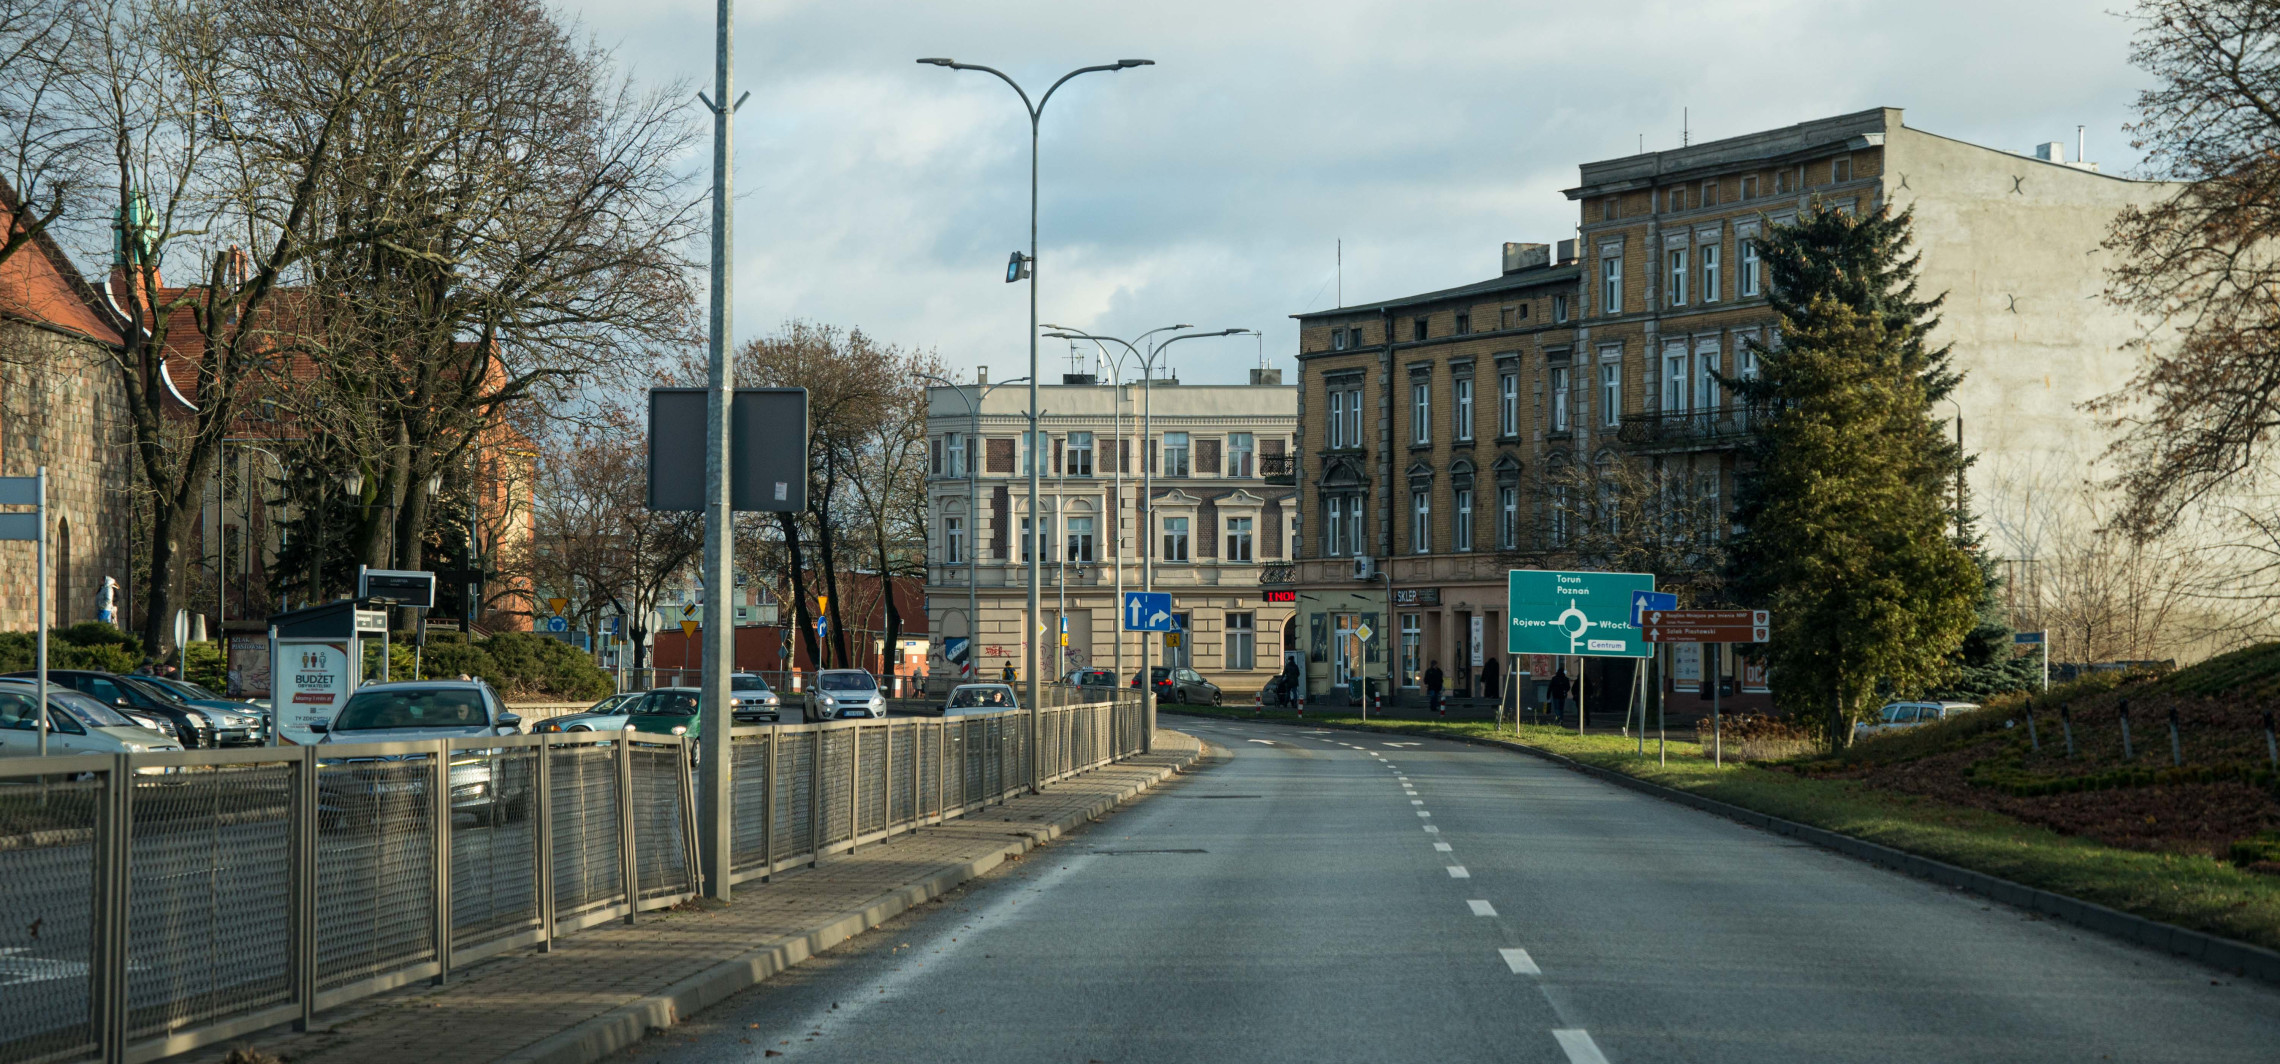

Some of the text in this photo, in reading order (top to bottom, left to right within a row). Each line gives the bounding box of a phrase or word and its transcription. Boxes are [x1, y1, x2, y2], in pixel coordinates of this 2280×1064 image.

[1556, 574, 1581, 584] Toruń
[1557, 586, 1590, 595] Poznań
[1397, 590, 1417, 603] SKLEP
[1513, 618, 1546, 627] Rojewo
[1599, 620, 1635, 630] Włocła
[1591, 641, 1622, 650] Centrum
[295, 673, 335, 684] BUDŻET
